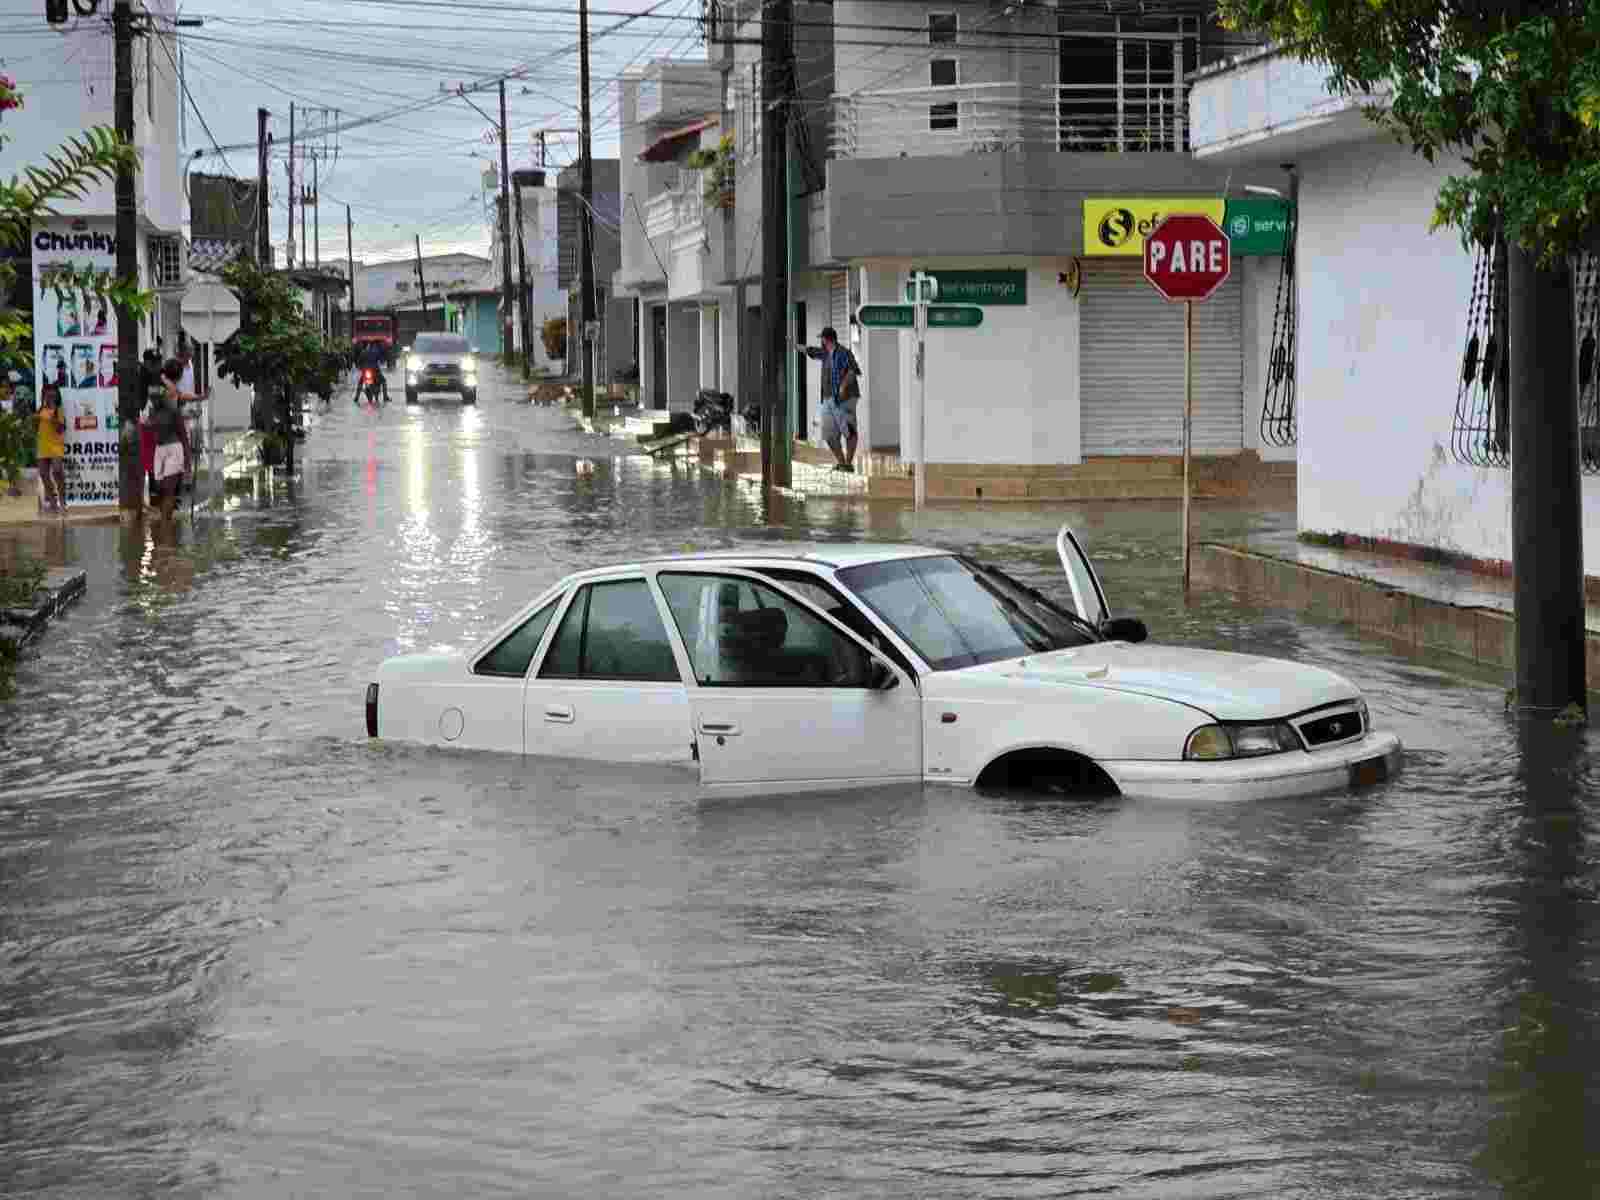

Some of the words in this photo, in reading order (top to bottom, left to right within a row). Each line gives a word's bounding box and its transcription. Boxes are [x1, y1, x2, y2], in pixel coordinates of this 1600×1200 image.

[35, 231, 115, 255] Chunky
[1150, 240, 1223, 274] PARE
[63, 441, 120, 455] ORARIO
